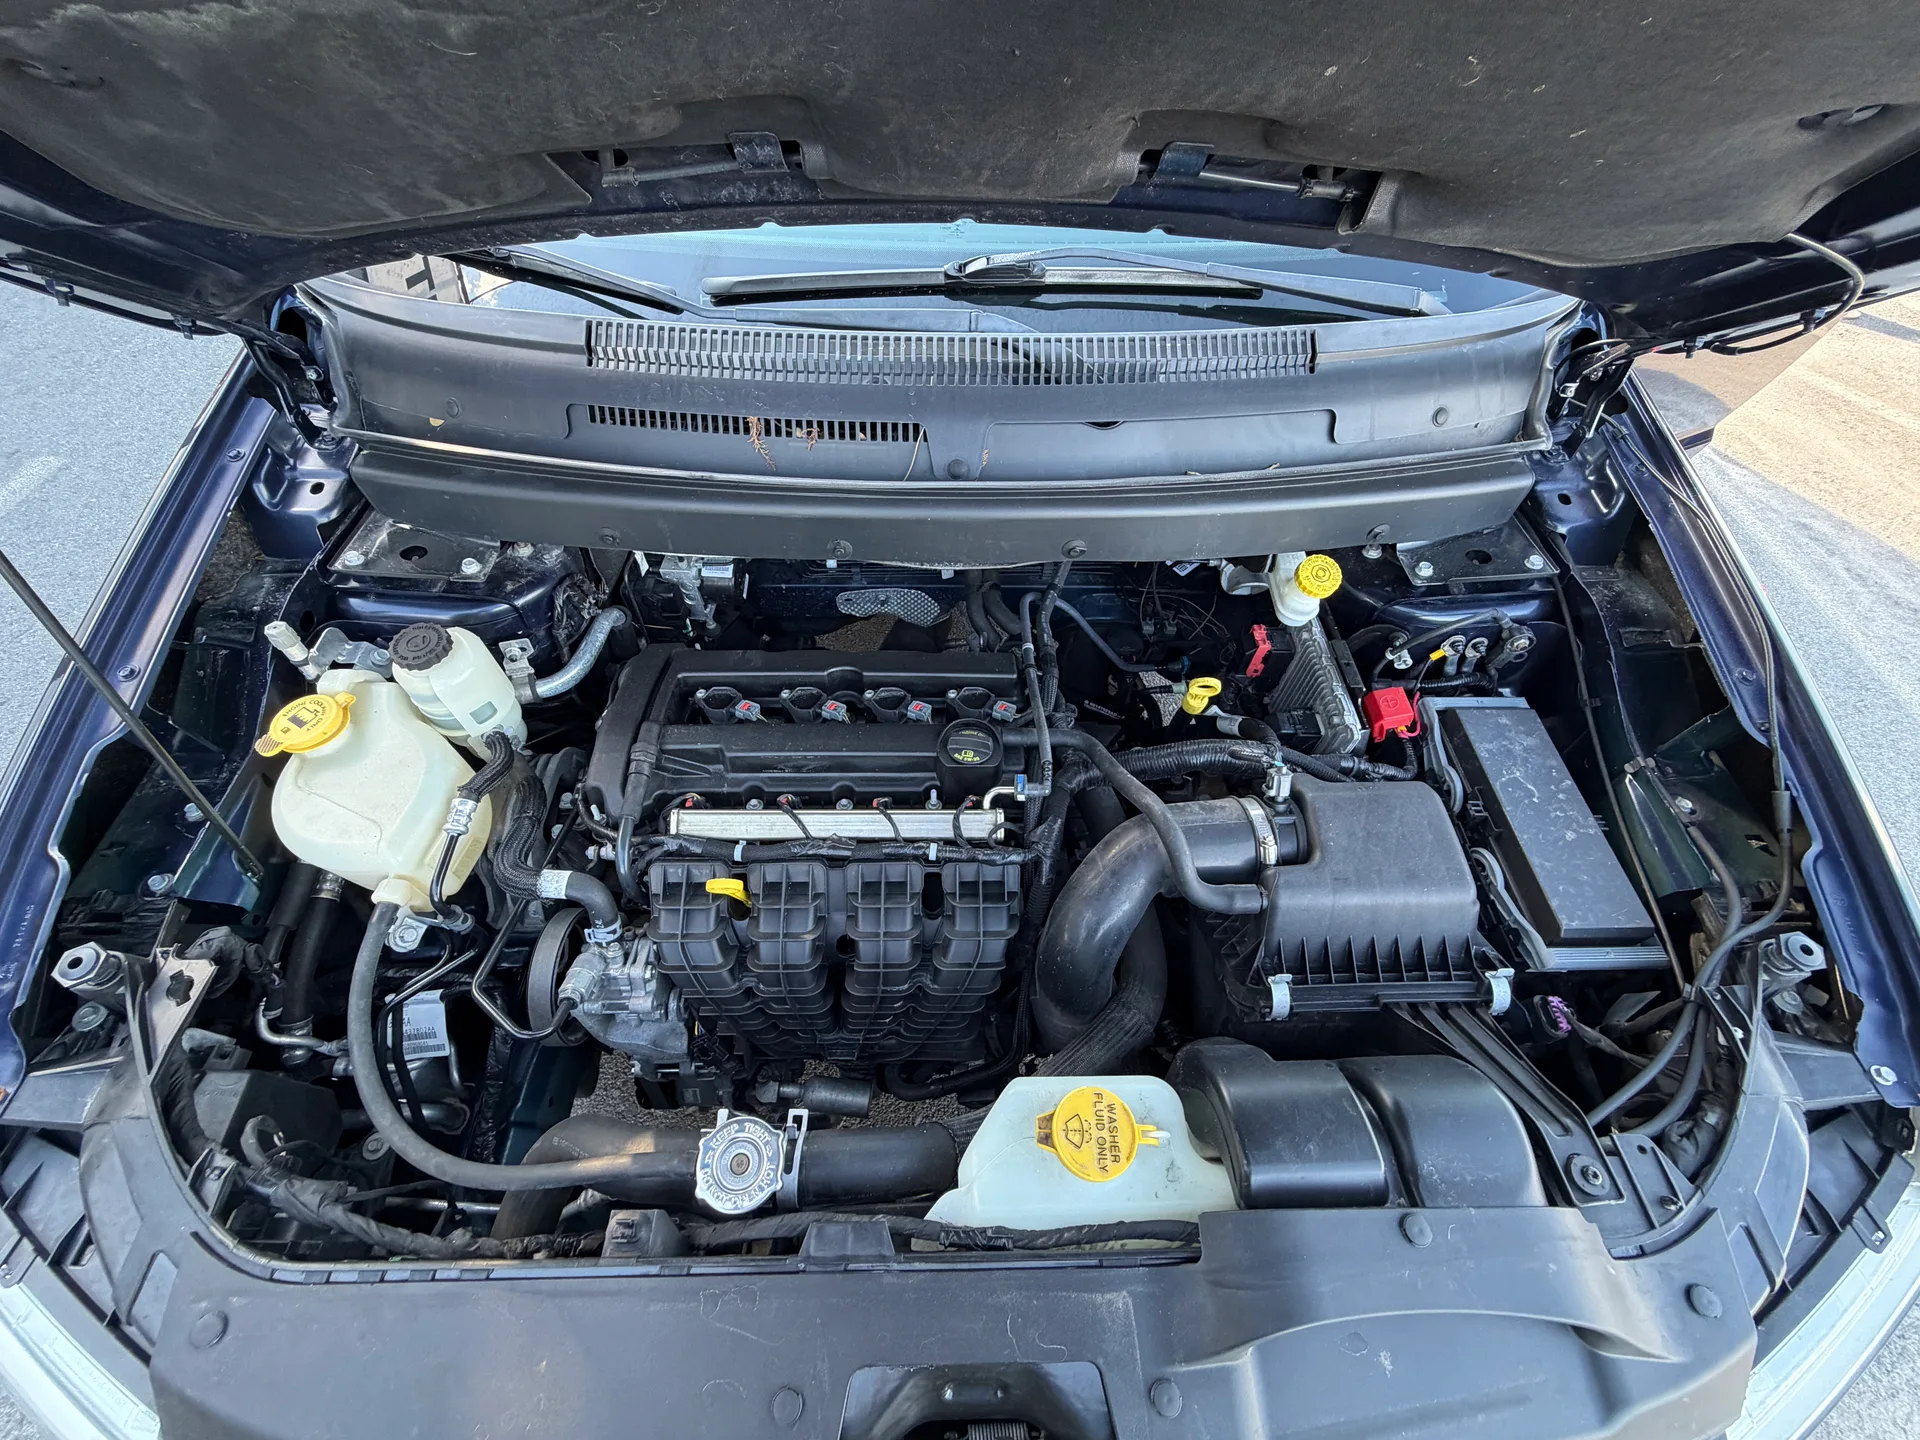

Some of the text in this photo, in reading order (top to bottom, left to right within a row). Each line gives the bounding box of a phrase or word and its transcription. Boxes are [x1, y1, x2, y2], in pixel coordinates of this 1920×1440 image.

[282, 699, 327, 732] ENGINE COOLANT ONLY
[710, 1122, 772, 1148] KEEP TIGHT
[1093, 1092, 1109, 1173] FLUID ONLY
[1106, 1103, 1121, 1164] WASHER
[759, 1162, 776, 1189] HOT
